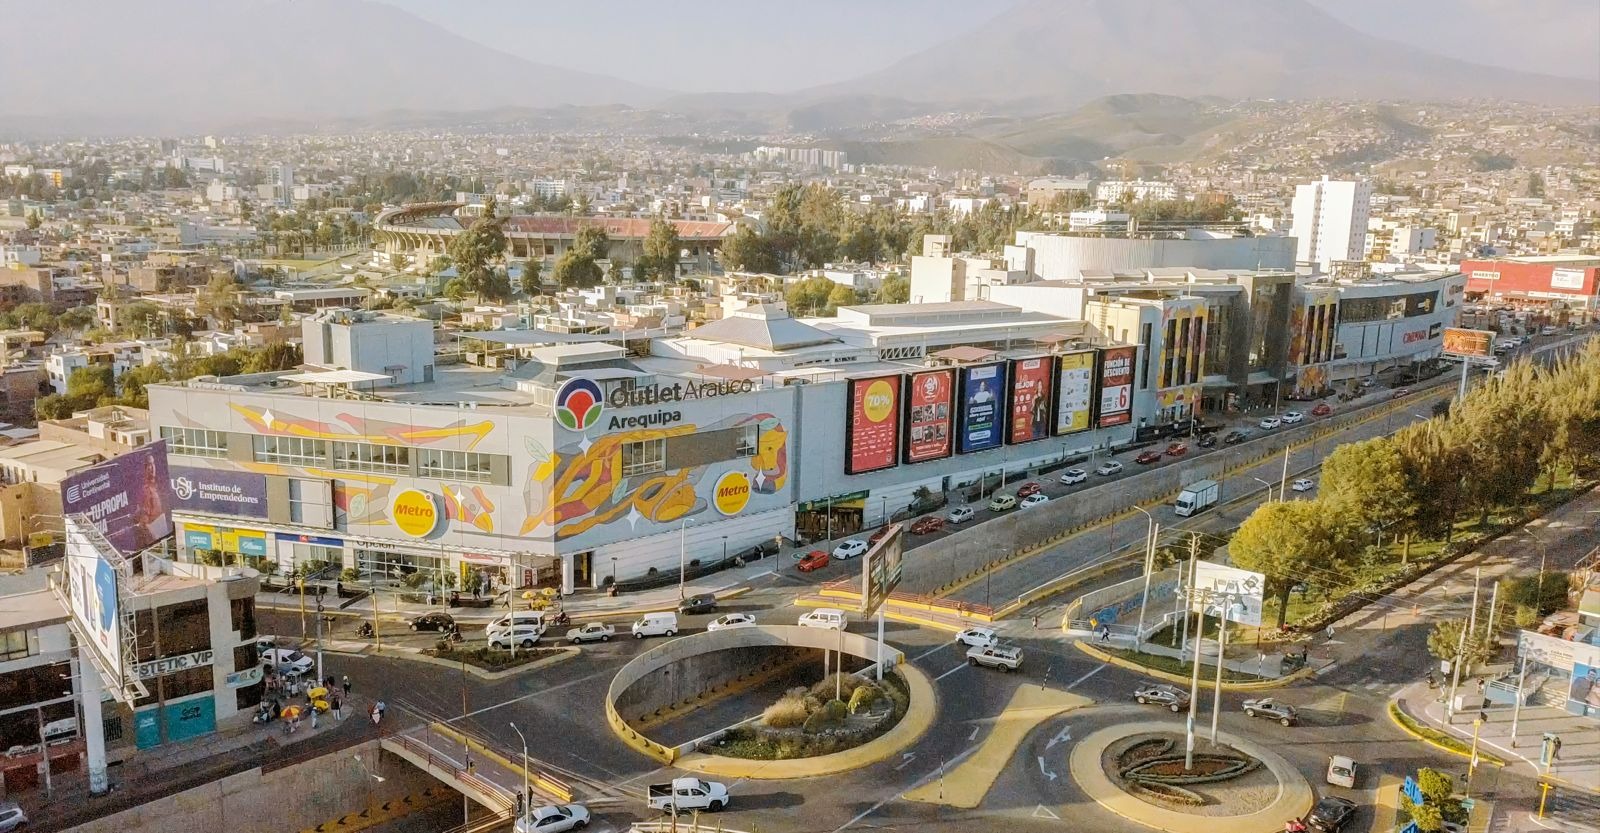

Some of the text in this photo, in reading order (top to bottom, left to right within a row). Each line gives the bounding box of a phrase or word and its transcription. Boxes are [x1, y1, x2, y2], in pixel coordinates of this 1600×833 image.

[1104, 366, 1130, 377] DESCUENTO
[868, 395, 890, 407] 70%
[1119, 386, 1127, 408] 6
[854, 385, 862, 425] OUTLET
[608, 409, 681, 430] Arequipa
[81, 472, 110, 490] Universidad
[198, 481, 241, 493] Instituto de
[82, 480, 111, 498] Continental
[718, 485, 749, 498] Metro
[101, 490, 129, 517] PROPIA
[199, 490, 259, 504] Emprendedores
[396, 504, 433, 518] Metro
[191, 651, 213, 665] VIP
